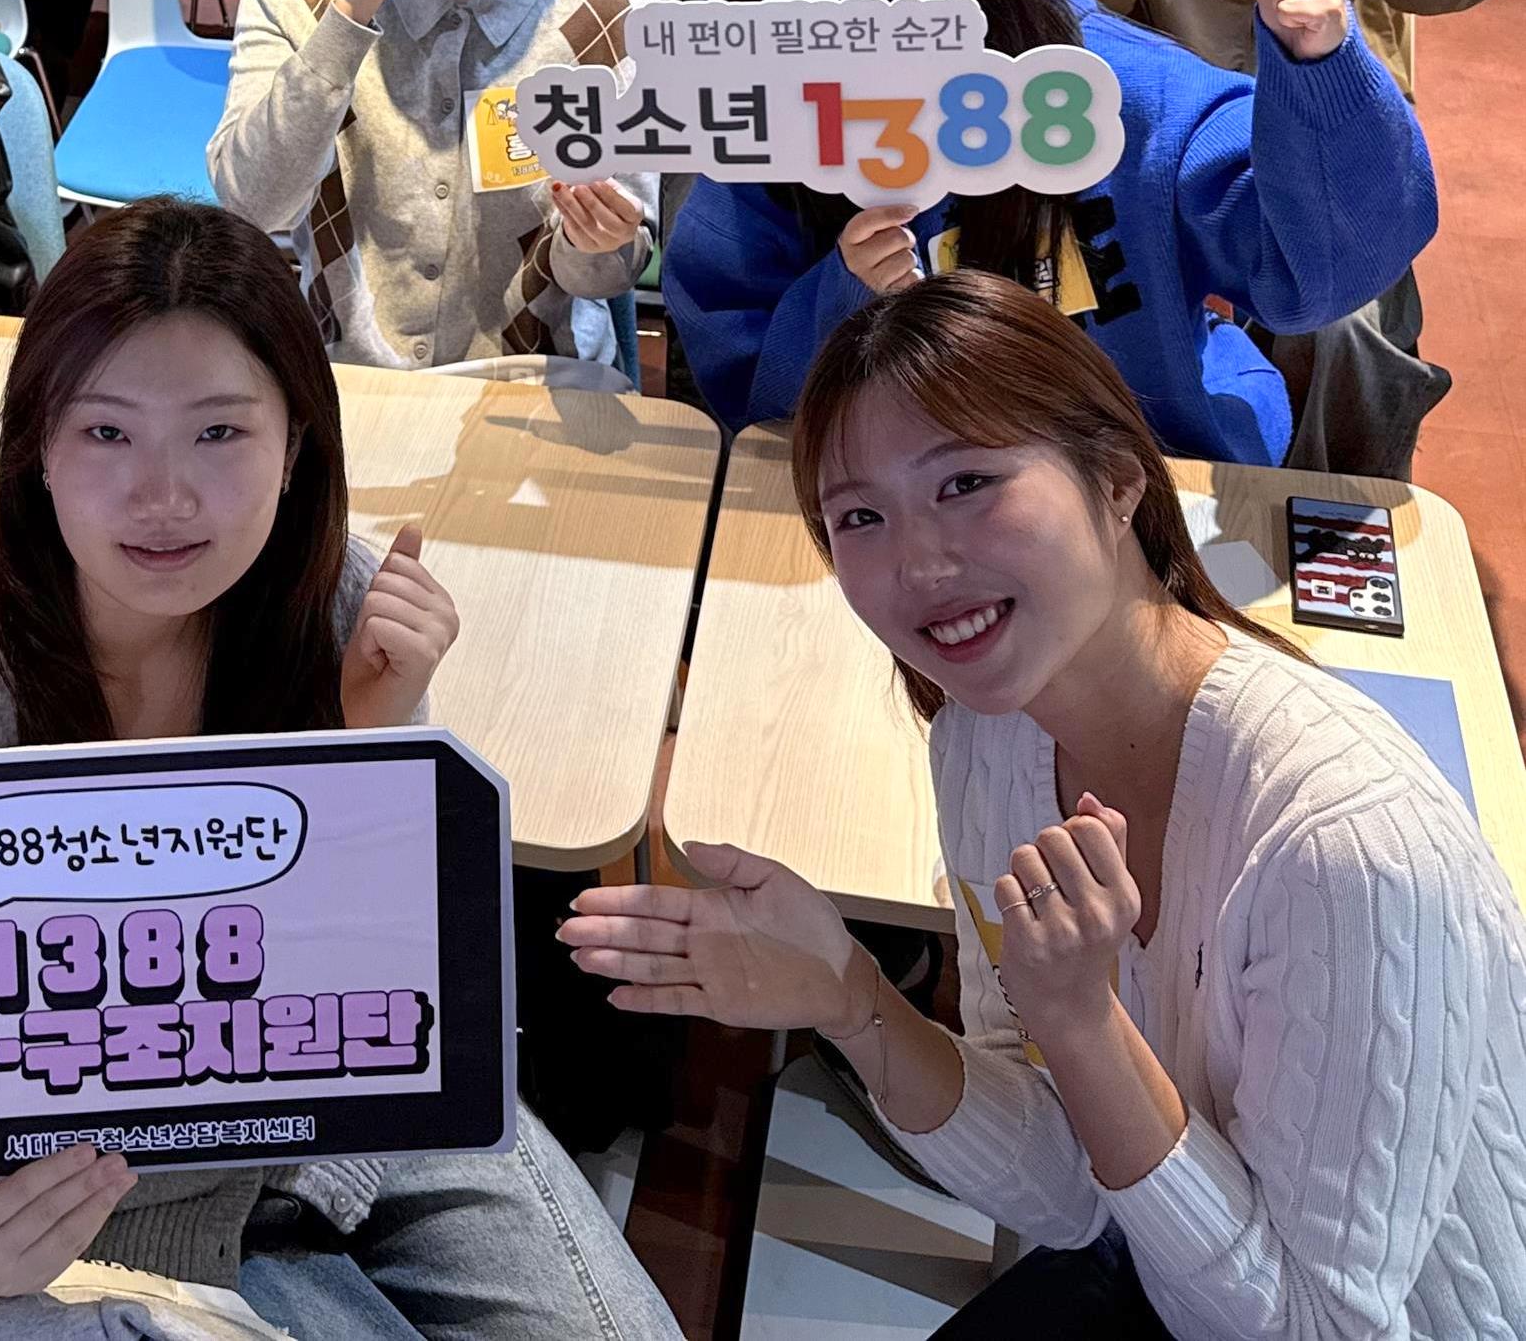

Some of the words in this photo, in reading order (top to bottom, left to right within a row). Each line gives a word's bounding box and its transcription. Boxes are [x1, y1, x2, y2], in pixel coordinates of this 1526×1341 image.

[642, 19, 676, 57] 내
[687, 18, 757, 56] 편이
[770, 15, 880, 54] 필요한
[891, 13, 968, 52] 순간
[533, 84, 771, 168] 청소년
[803, 70, 1096, 189] 1388
